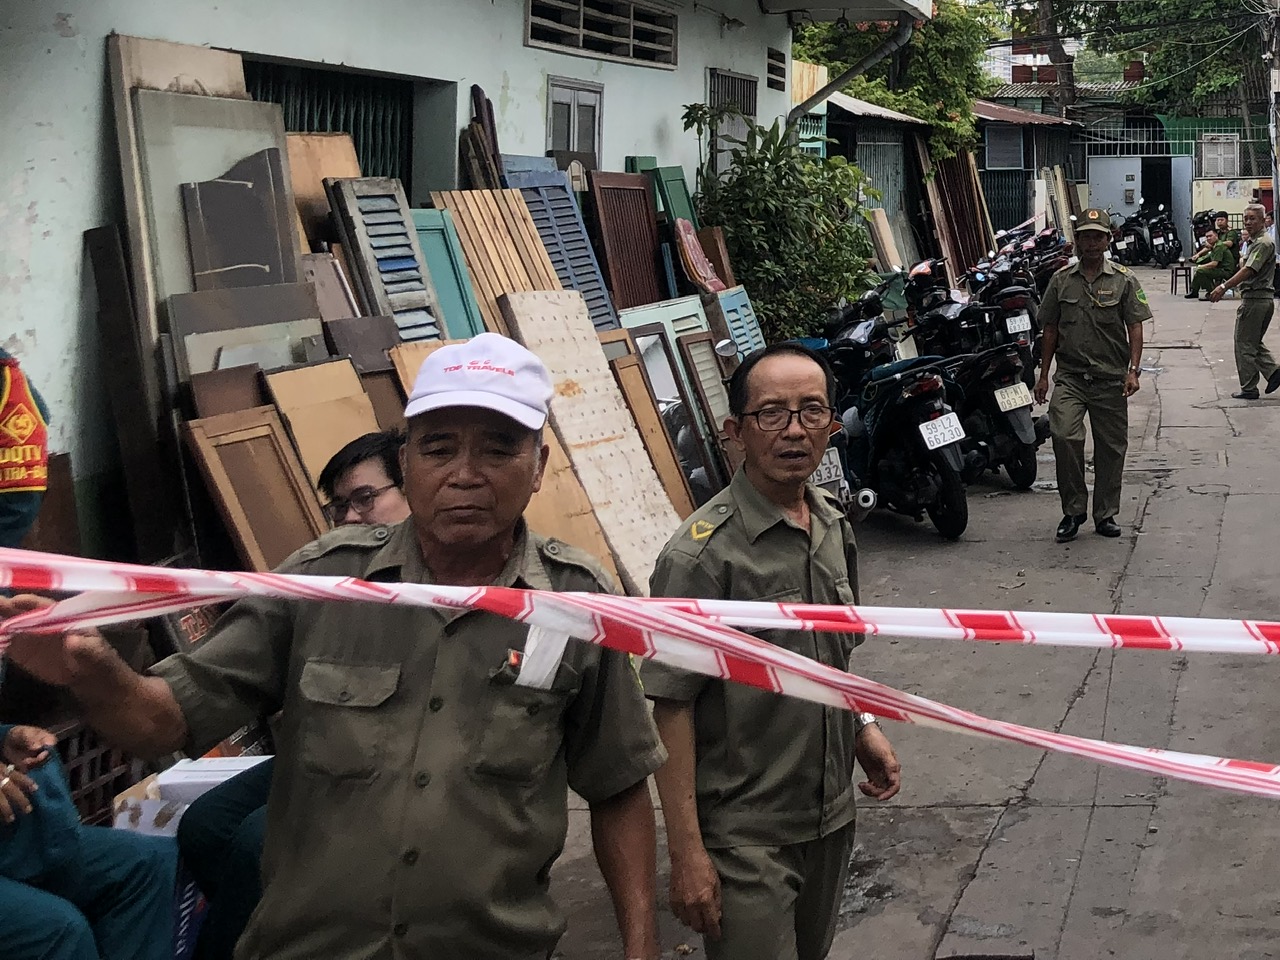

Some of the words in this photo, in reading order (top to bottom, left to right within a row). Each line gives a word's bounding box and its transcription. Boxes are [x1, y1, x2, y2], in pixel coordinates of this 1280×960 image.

[443, 365, 463, 373] TOP
[925, 416, 955, 435] 59-L2
[927, 427, 962, 448] 662.30
